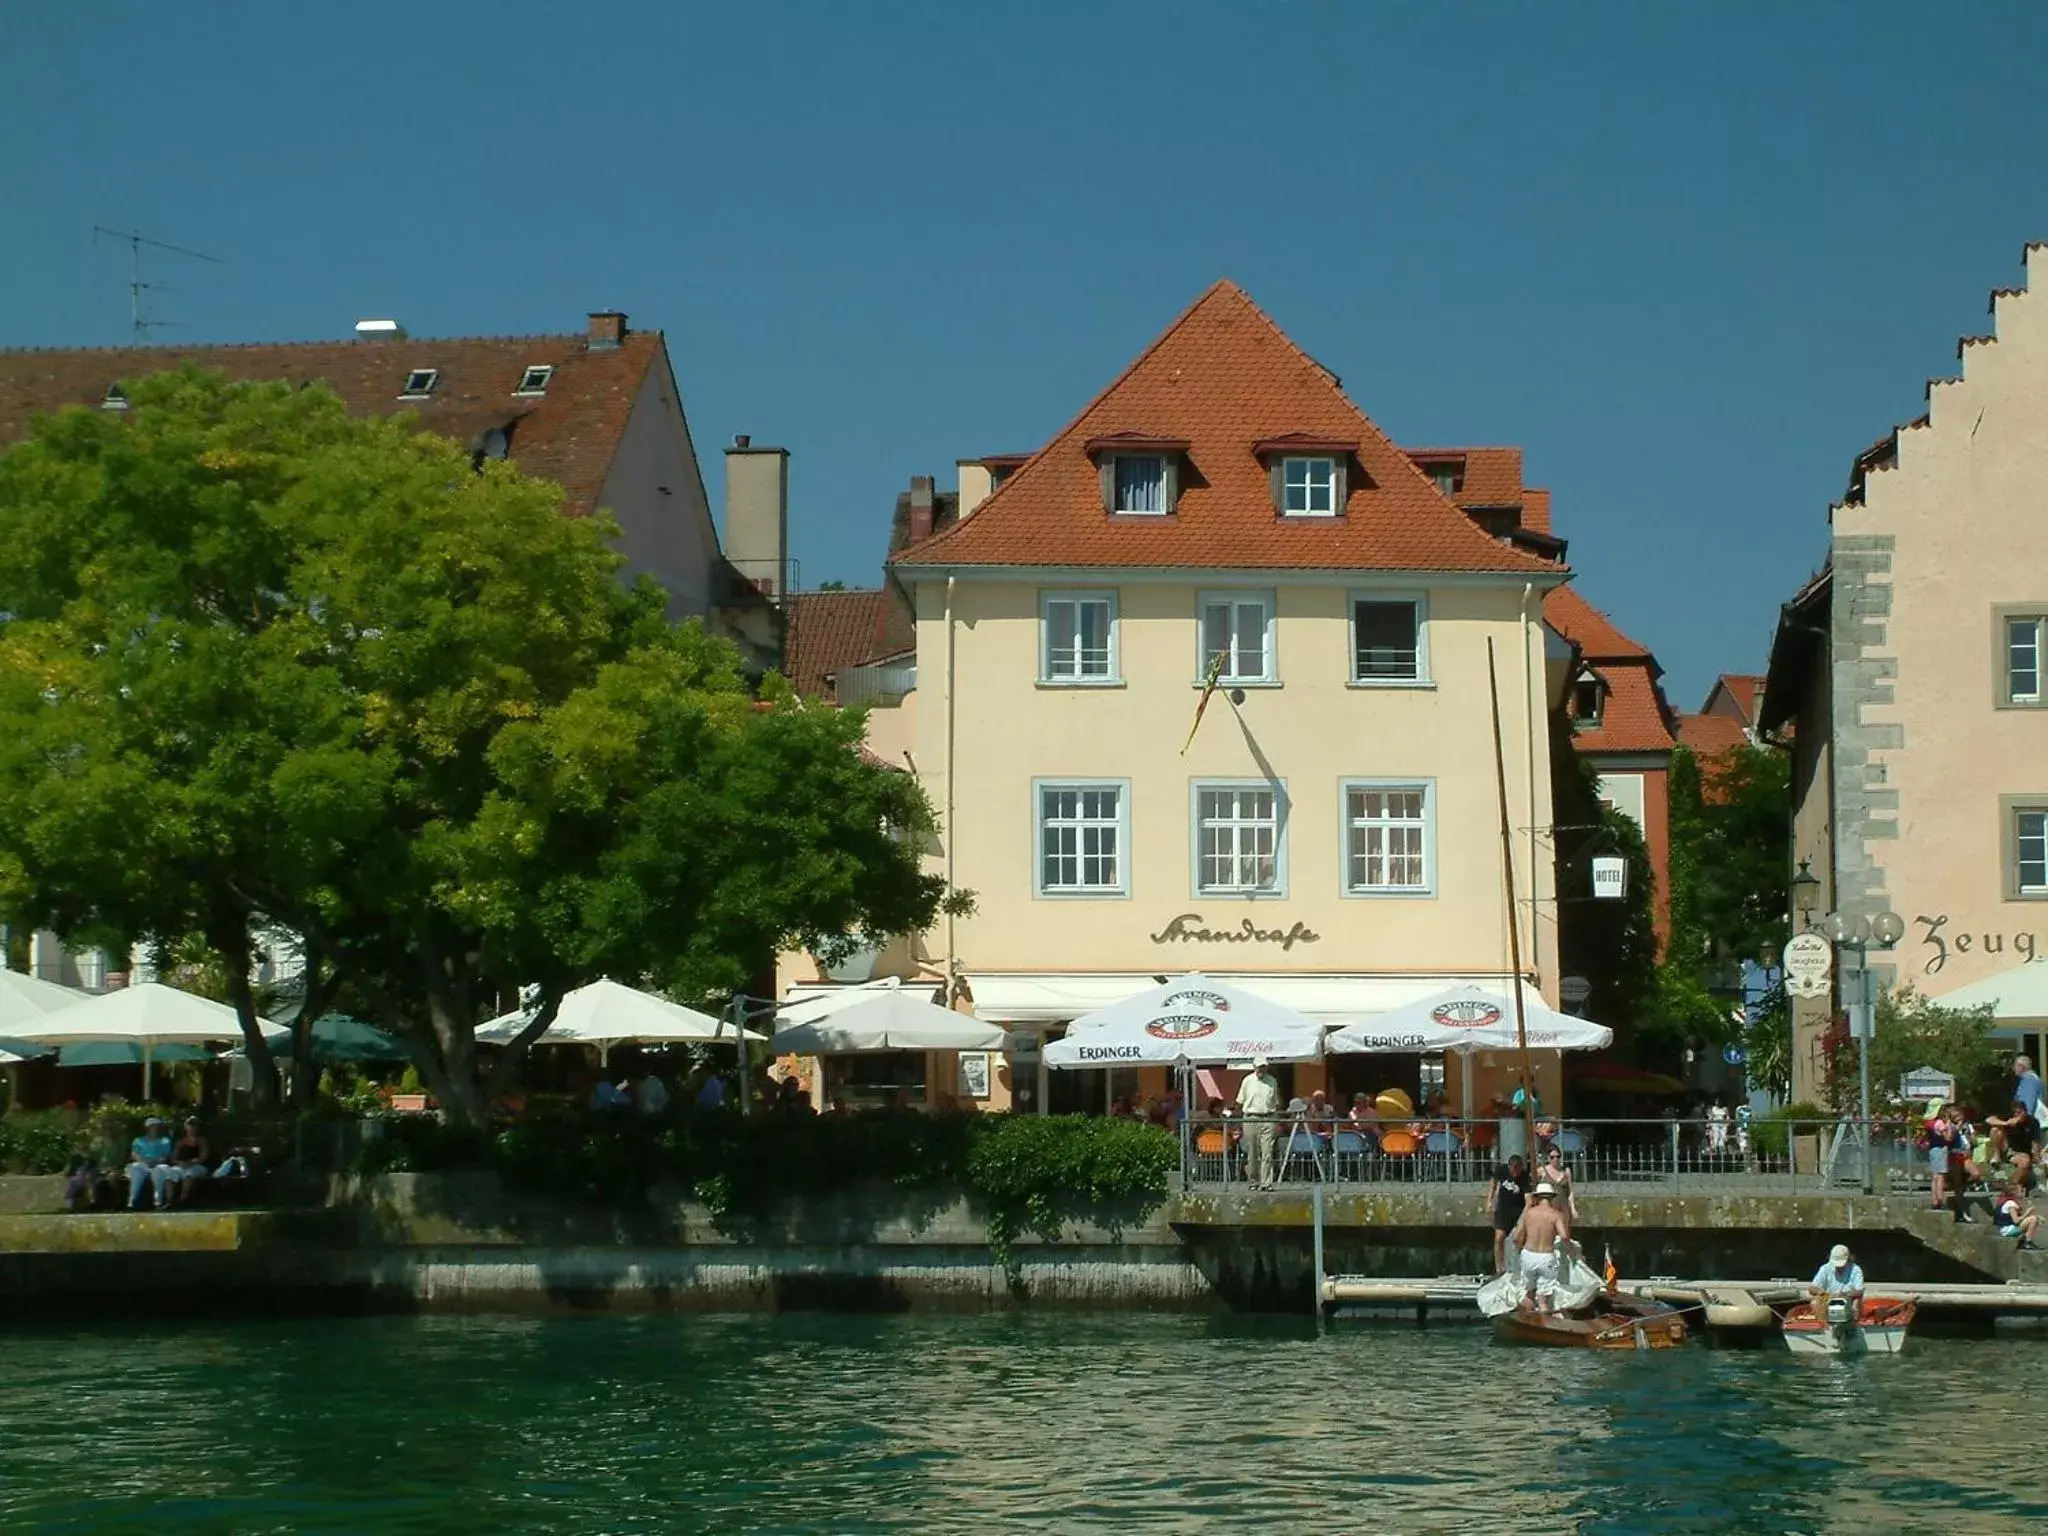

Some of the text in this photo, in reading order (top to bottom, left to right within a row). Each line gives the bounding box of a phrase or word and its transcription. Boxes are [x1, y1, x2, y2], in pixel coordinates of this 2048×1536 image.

[1595, 869, 1621, 882] HOTEL
[1363, 1034, 1426, 1047] ERDINGER
[1079, 1045, 1142, 1060] ERDINGER
